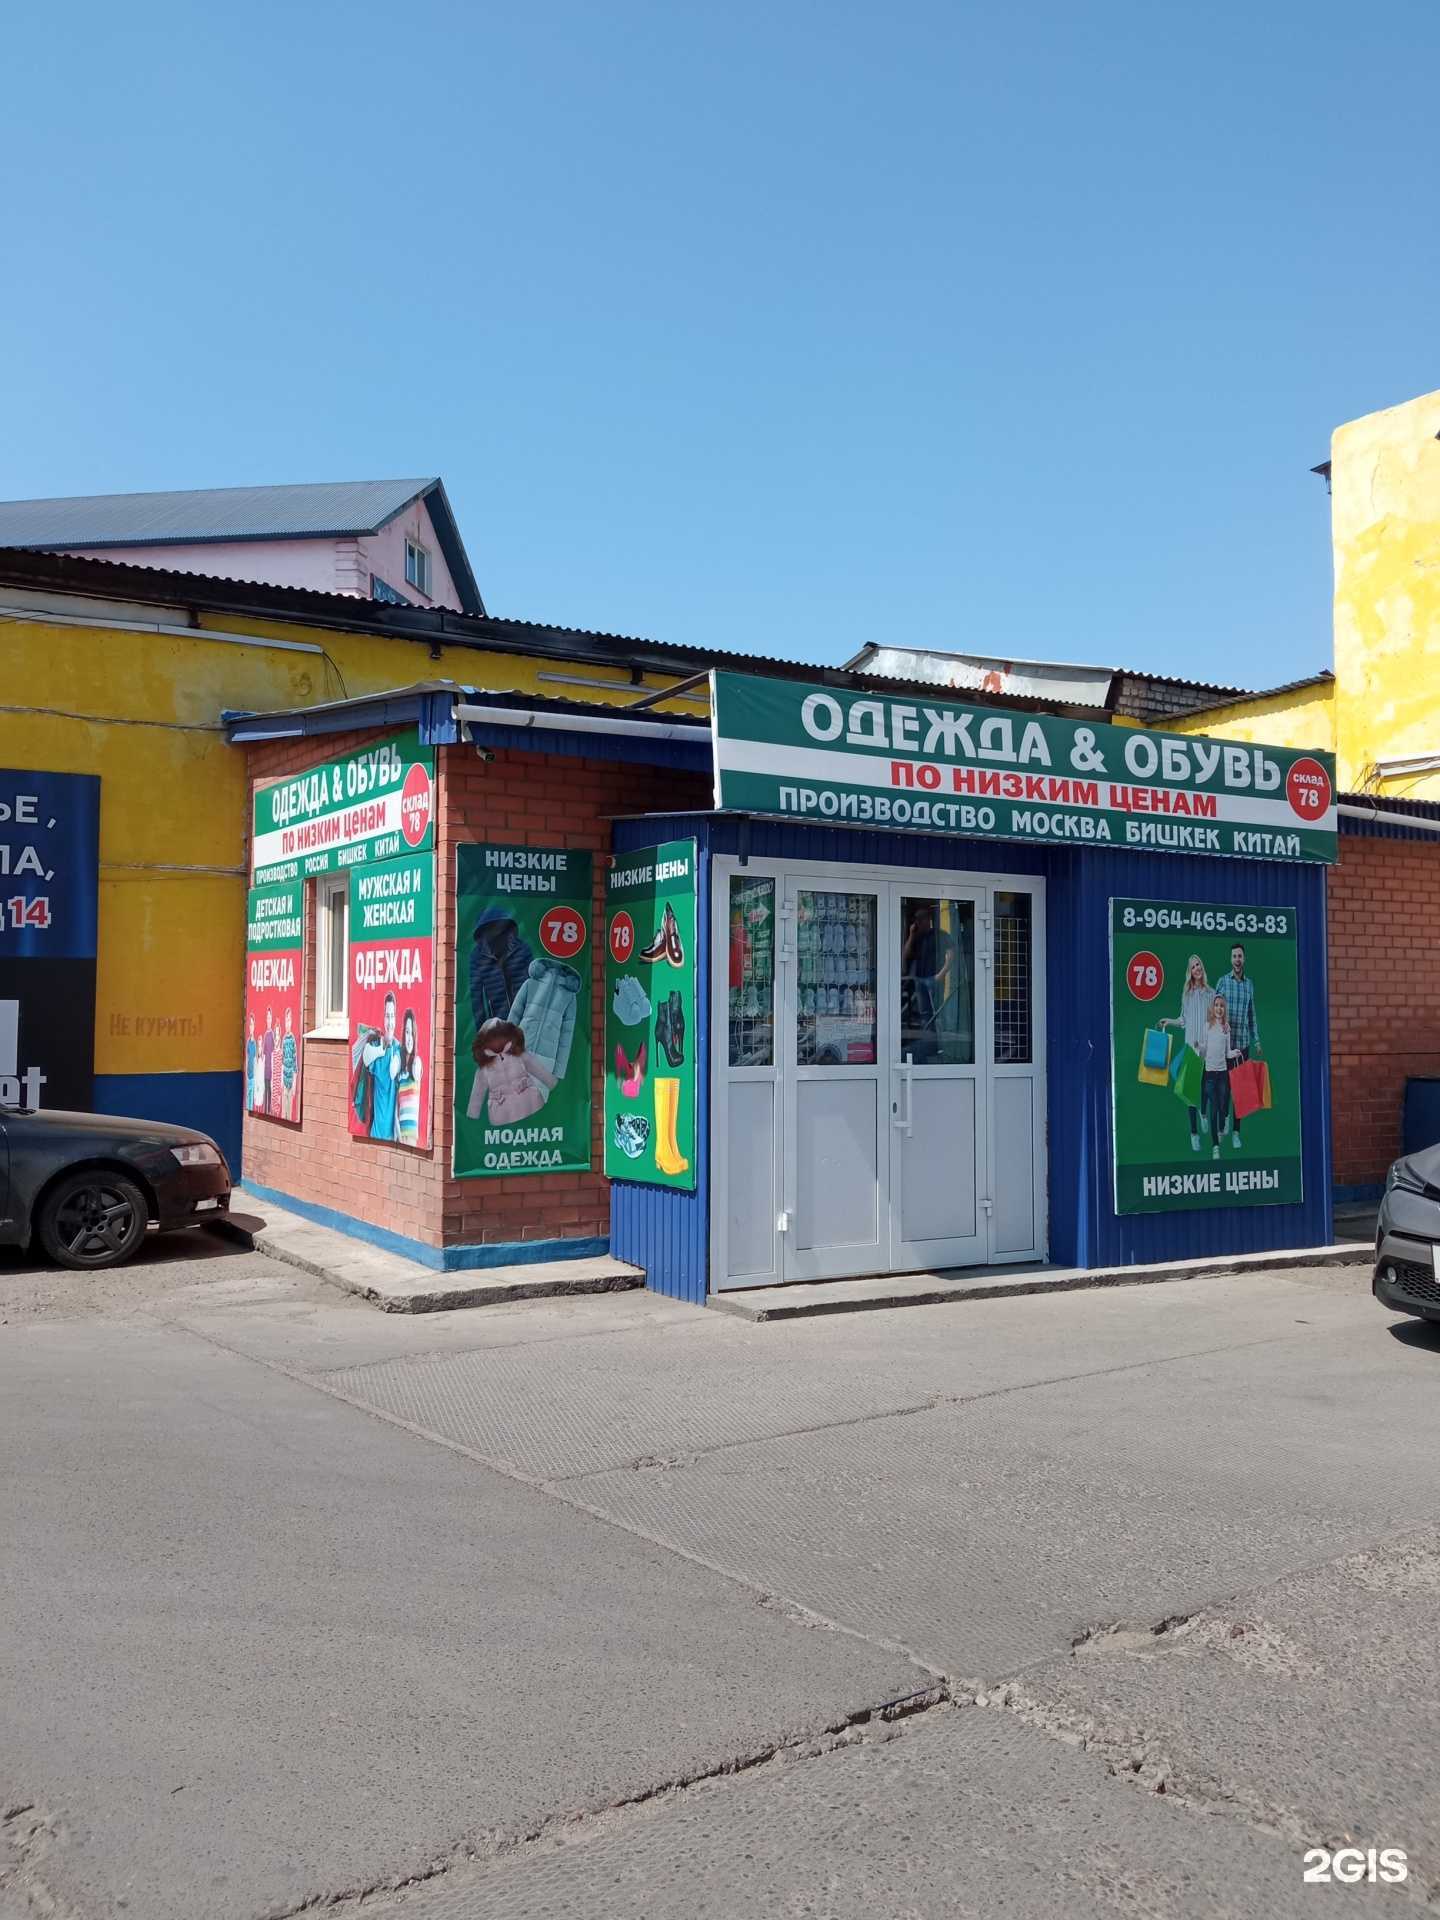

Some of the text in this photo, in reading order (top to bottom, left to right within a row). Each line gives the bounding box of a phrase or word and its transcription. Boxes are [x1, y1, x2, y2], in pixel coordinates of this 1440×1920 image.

[801, 693, 1281, 791] ОДЕЖДА & ОБУВЬ
[272, 743, 402, 827] ОДЕЖДА & ОБУВЬ
[891, 761, 1217, 818] ПО НИЗКИМ ЦЕНАМ
[1298, 788, 1319, 808] 78
[409, 812, 420, 833] 78
[779, 786, 1300, 857] ПРОИЗВОДСТВО МОСКВА БИШКЕК КИТАЙ
[256, 832, 400, 884] ПРОИЗВОДСТВО РОССИЯ БИШКЕК КИТАЙ
[485, 851, 567, 870] НИЗКИЕ
[359, 868, 421, 900] МУЖСКАЯ И
[496, 873, 556, 892] ЦЕНЫ
[610, 858, 688, 888] НИЗКИЕ ЦЕНЫ
[256, 895, 293, 921] ДЕТСКАЯ И
[363, 899, 415, 928] ЖЕНСКАЯ
[1123, 907, 1287, 934] 8-964-465-63-83
[248, 917, 301, 943] ПОДРОСТКОВАЯ
[547, 922, 578, 942] 78
[613, 926, 630, 948] 78
[251, 958, 294, 992] ОДЕЖДА
[355, 948, 422, 990] ОДЕЖДА
[1133, 966, 1157, 986] 78
[484, 1127, 563, 1146] МОДНАЯ
[483, 1150, 562, 1169] ОДЕЖДА
[1143, 1170, 1279, 1196] НИЗКИЕ ЦЕНЫ
